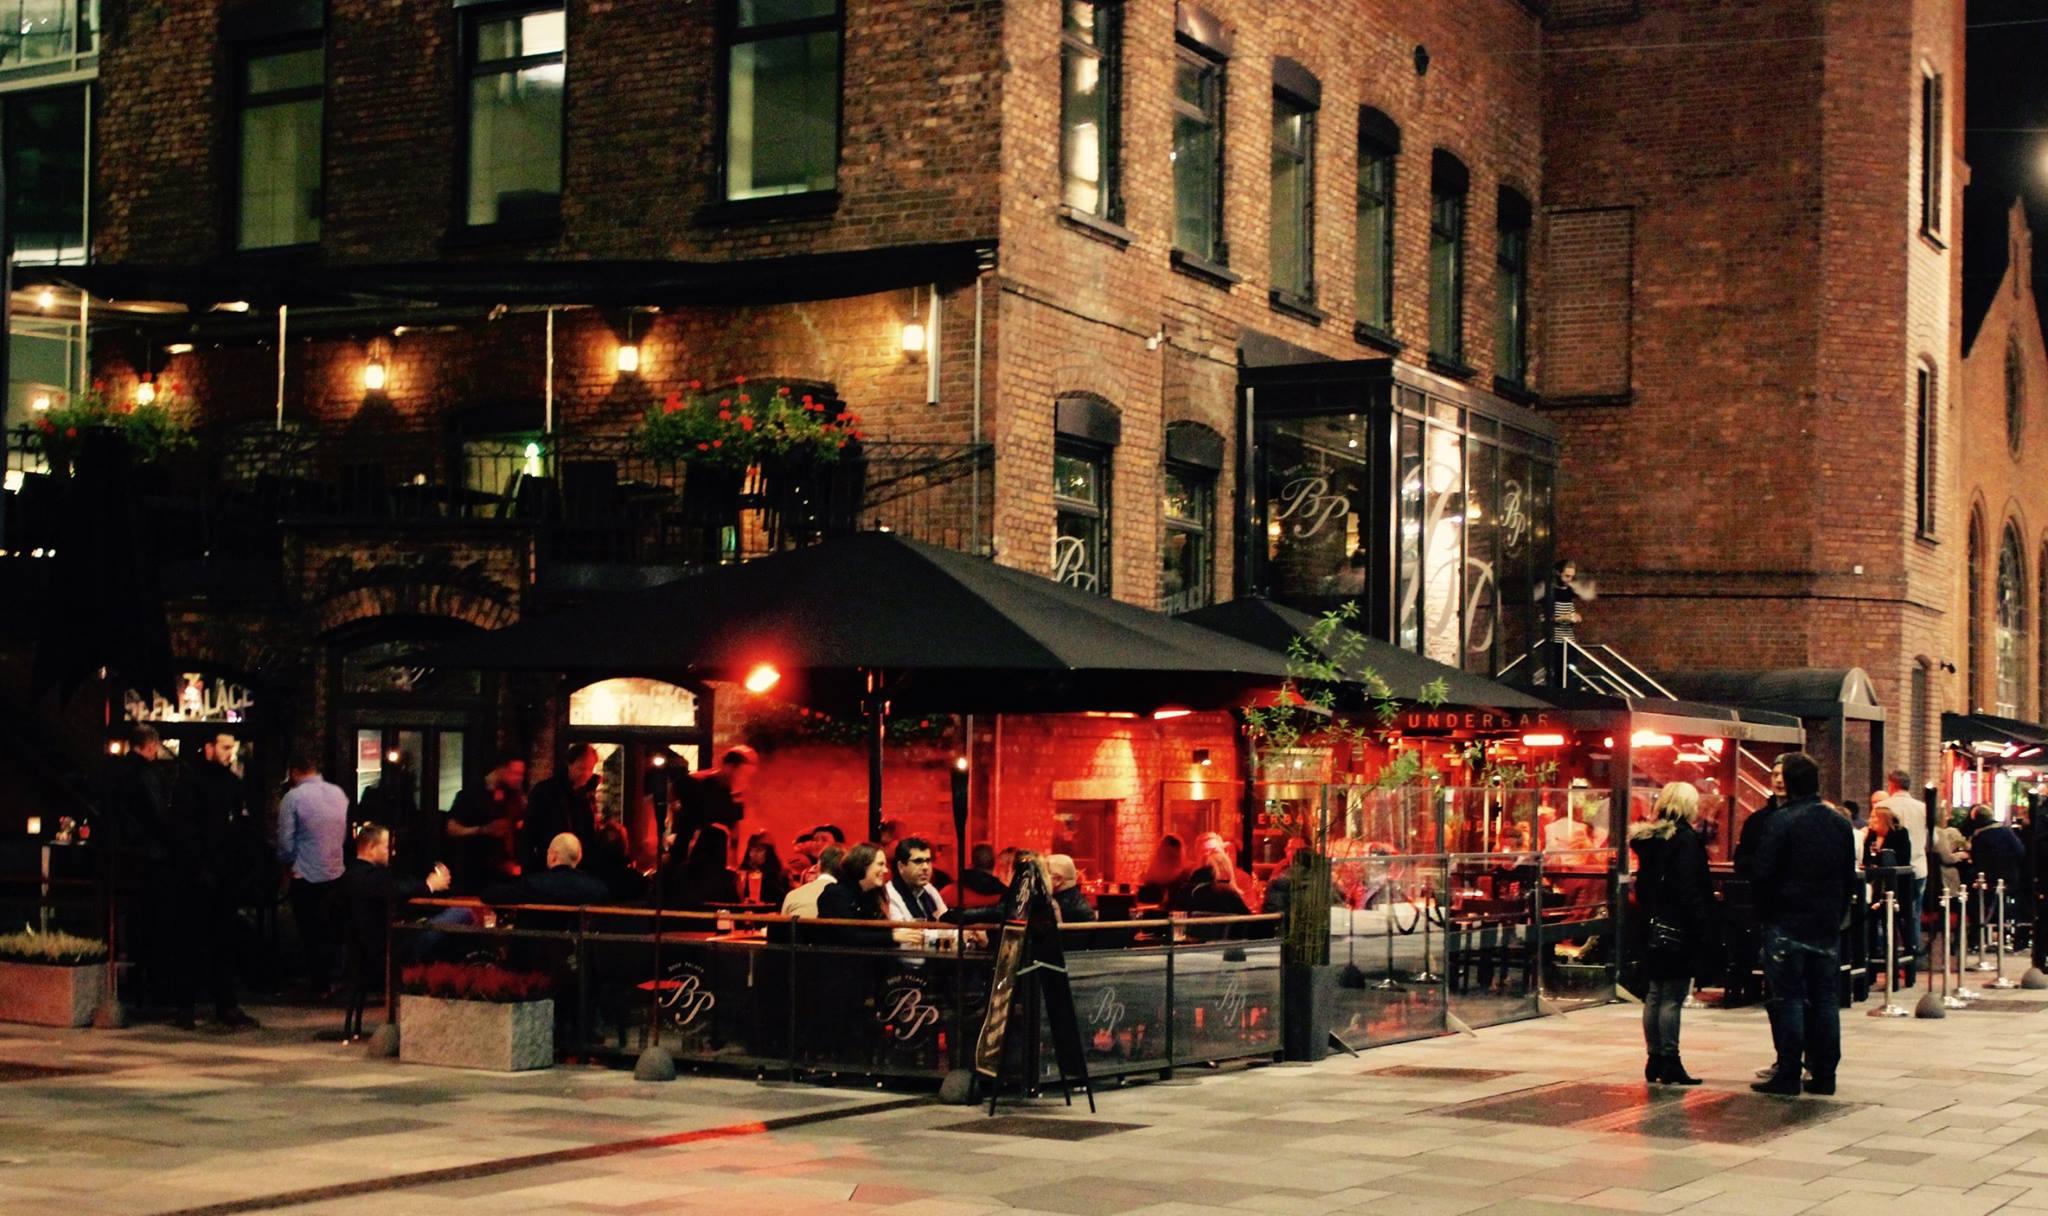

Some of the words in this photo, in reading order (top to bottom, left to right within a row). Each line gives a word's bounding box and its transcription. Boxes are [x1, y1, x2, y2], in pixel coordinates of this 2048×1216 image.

[1275, 477, 1350, 538] BP
[1408, 713, 1549, 729] UNDERBAR
[658, 974, 716, 1025] BP
[876, 988, 940, 1040] BP
